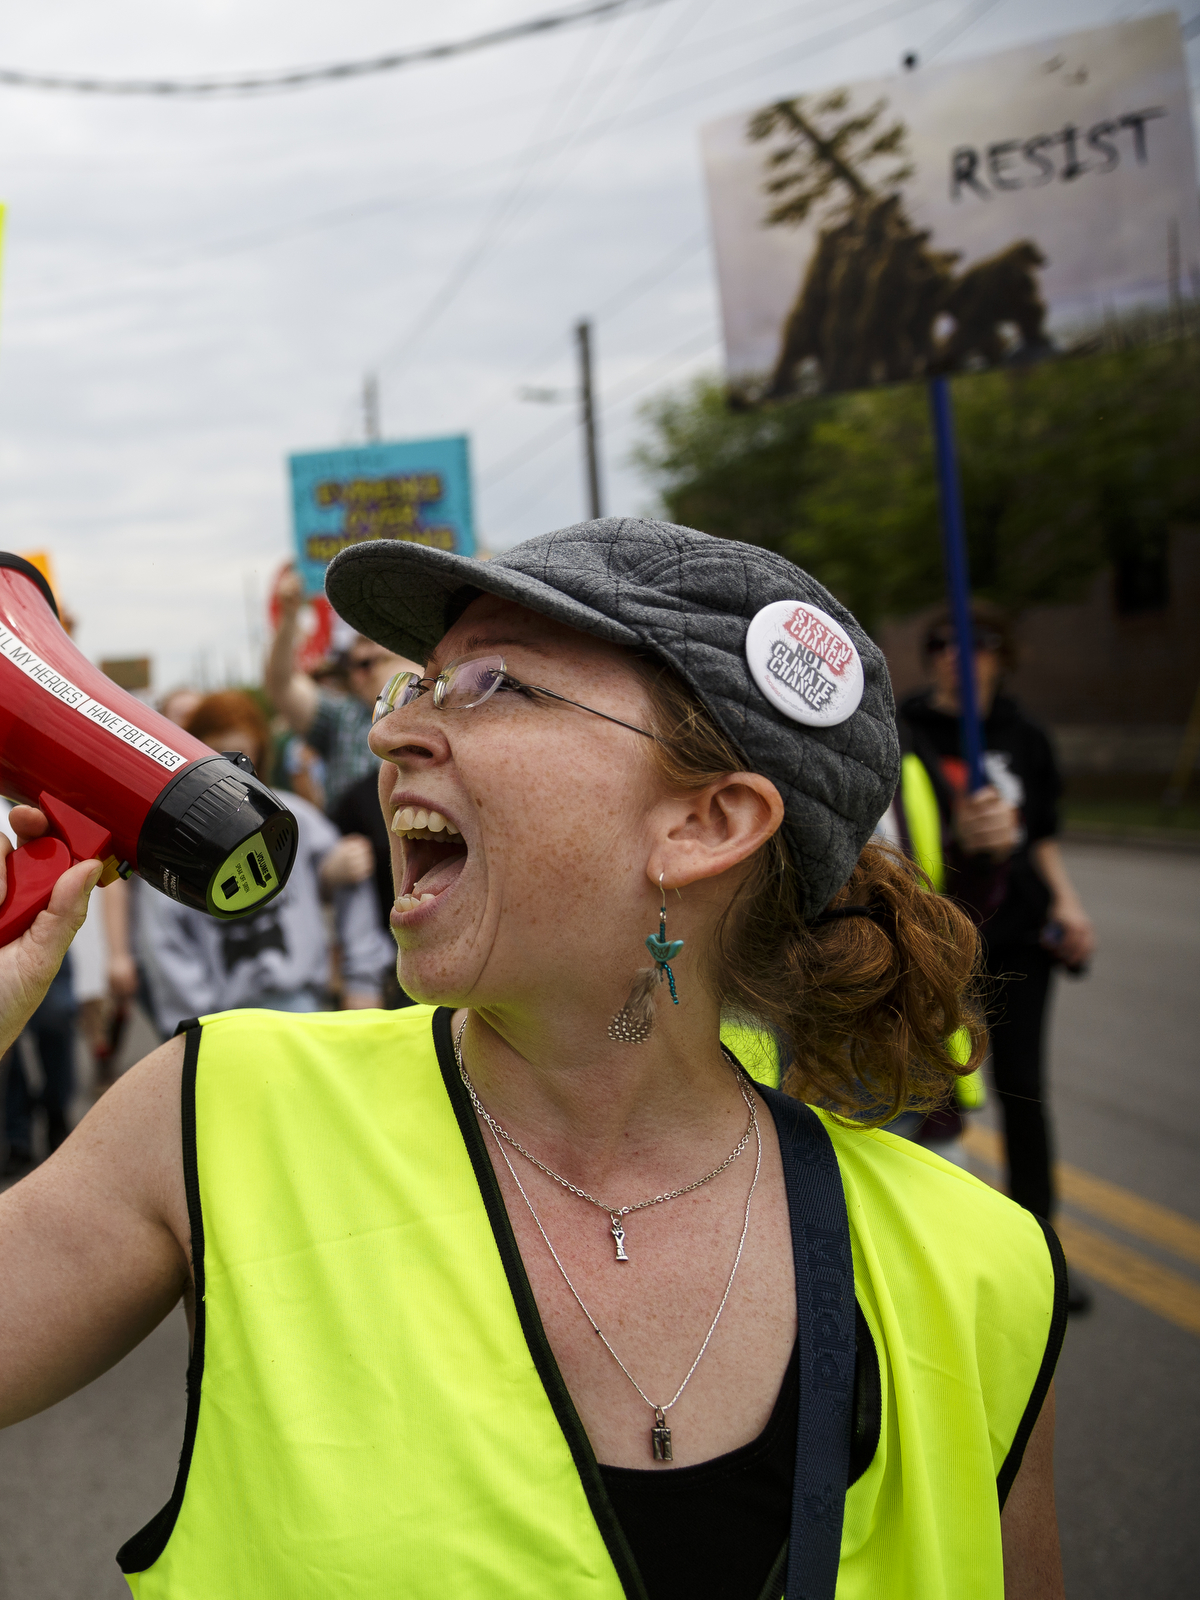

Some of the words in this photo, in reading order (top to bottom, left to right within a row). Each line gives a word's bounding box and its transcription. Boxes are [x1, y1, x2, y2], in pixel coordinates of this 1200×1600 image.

[948, 106, 1166, 203] RESIST
[790, 620, 844, 671] CHANGE
[795, 609, 850, 661] SYSTEM
[796, 643, 826, 671] NOT
[768, 657, 824, 710] CHANGE
[773, 643, 834, 699] CLIMATE
[10, 646, 36, 666] MY
[29, 664, 83, 704] HEROES
[86, 704, 122, 730] HAVE
[117, 724, 145, 744] FBI
[139, 739, 180, 767] FILES
[256, 852, 269, 876] VOLUME
